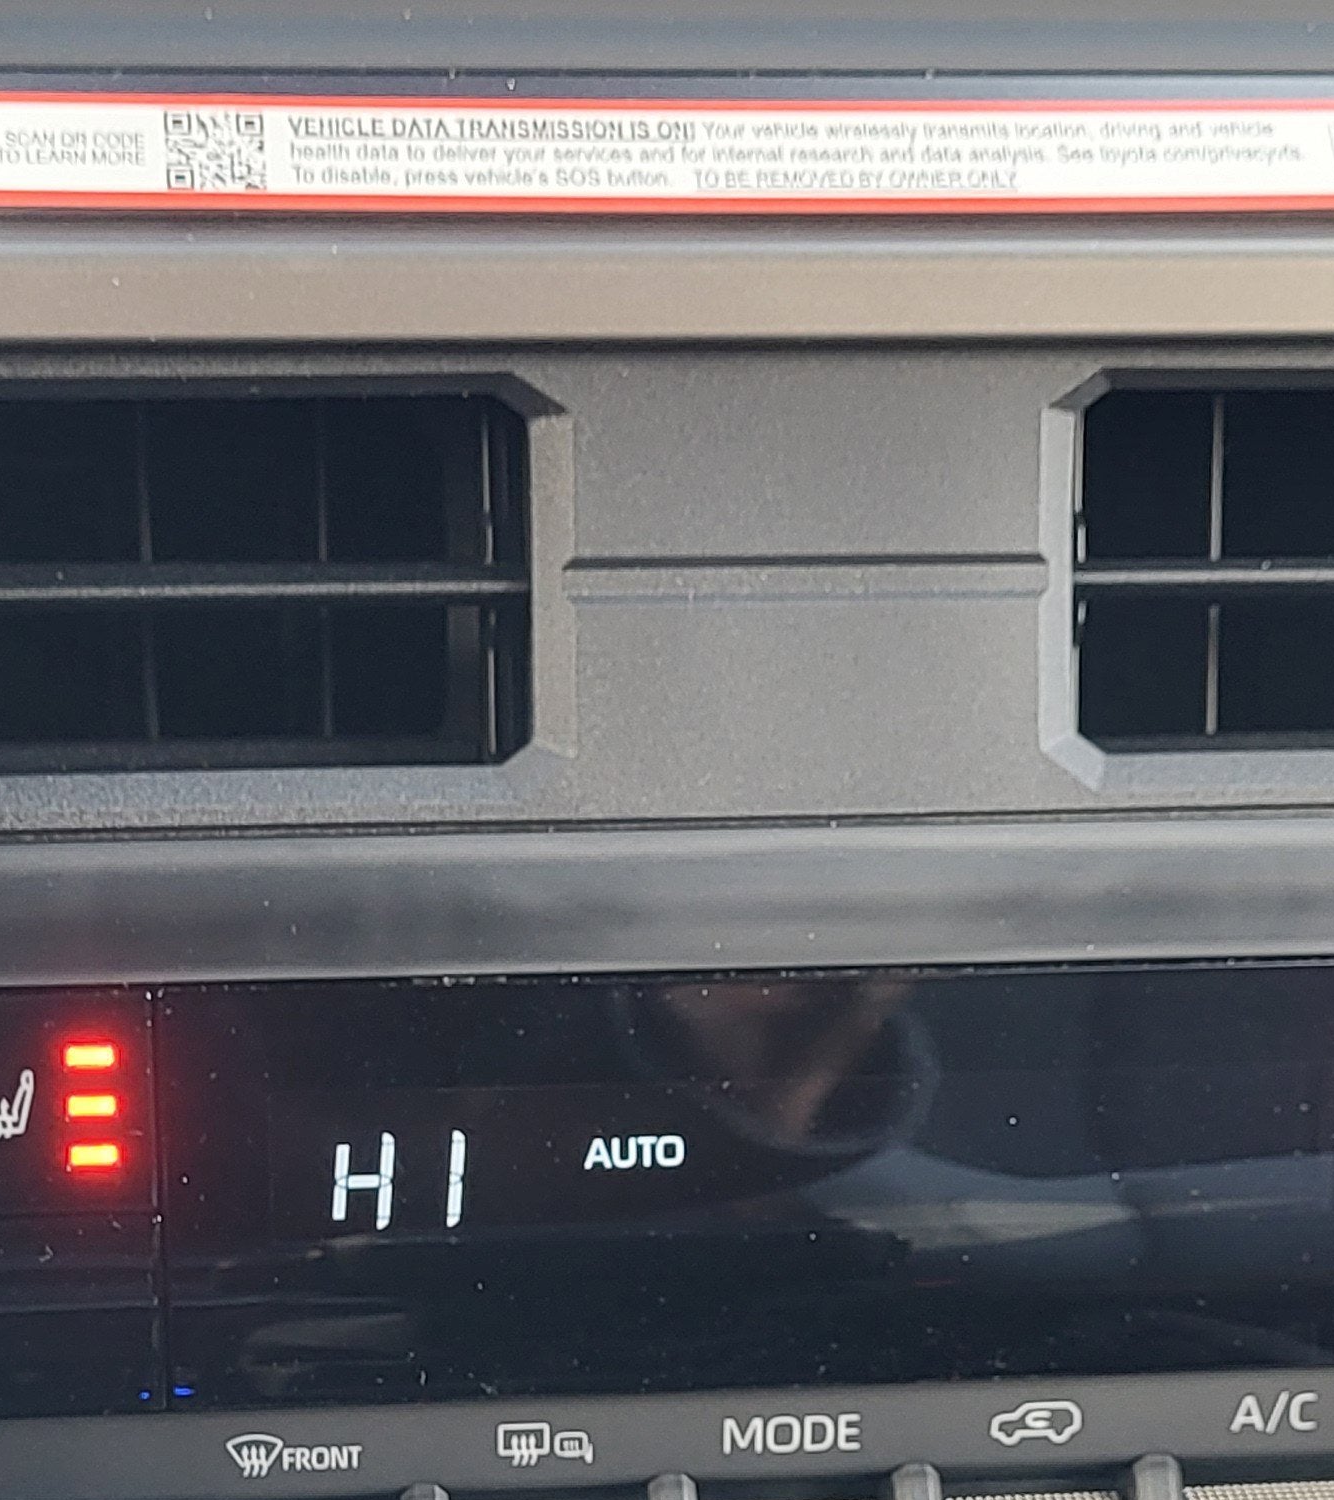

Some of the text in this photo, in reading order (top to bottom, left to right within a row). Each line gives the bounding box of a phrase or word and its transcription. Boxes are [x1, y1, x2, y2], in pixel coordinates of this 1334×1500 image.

[5, 130, 146, 150] SCAN QR CODE
[288, 116, 384, 138] VEHICLE
[393, 117, 451, 139] DATA
[455, 118, 624, 141] TRANSMISSION
[630, 119, 651, 141] IS
[702, 121, 745, 141] Your
[752, 121, 820, 141] vehicle
[825, 121, 917, 147] wirelessly
[923, 121, 1010, 140] transmits
[1099, 120, 1161, 142] driving
[1169, 120, 1203, 139] and
[1210, 120, 1275, 138] vehicle
[26, 148, 87, 167] LEARN
[92, 149, 146, 168] MORE
[290, 141, 350, 162] health
[356, 142, 400, 162] data
[408, 142, 427, 162] to
[433, 142, 497, 163] deliver
[504, 145, 546, 167] your
[553, 145, 634, 163] services
[640, 145, 675, 163] and
[681, 143, 707, 163] for
[712, 144, 785, 164] internal
[790, 144, 874, 164] research
[880, 144, 916, 164] and
[921, 145, 962, 164] data
[1057, 143, 1095, 165] See
[292, 163, 315, 184] To
[406, 168, 460, 189] press
[555, 167, 602, 187] SOS
[694, 168, 720, 190] TO
[724, 168, 751, 190] BE
[756, 168, 853, 190] REMOVED
[858, 168, 885, 190] BY
[889, 168, 963, 190] OWNER
[967, 168, 1018, 190] ONLY
[583, 1134, 685, 1171] AUTO
[1229, 1391, 1319, 1434] A/C
[722, 1412, 861, 1455] MODE
[281, 1445, 363, 1472] FRONT
